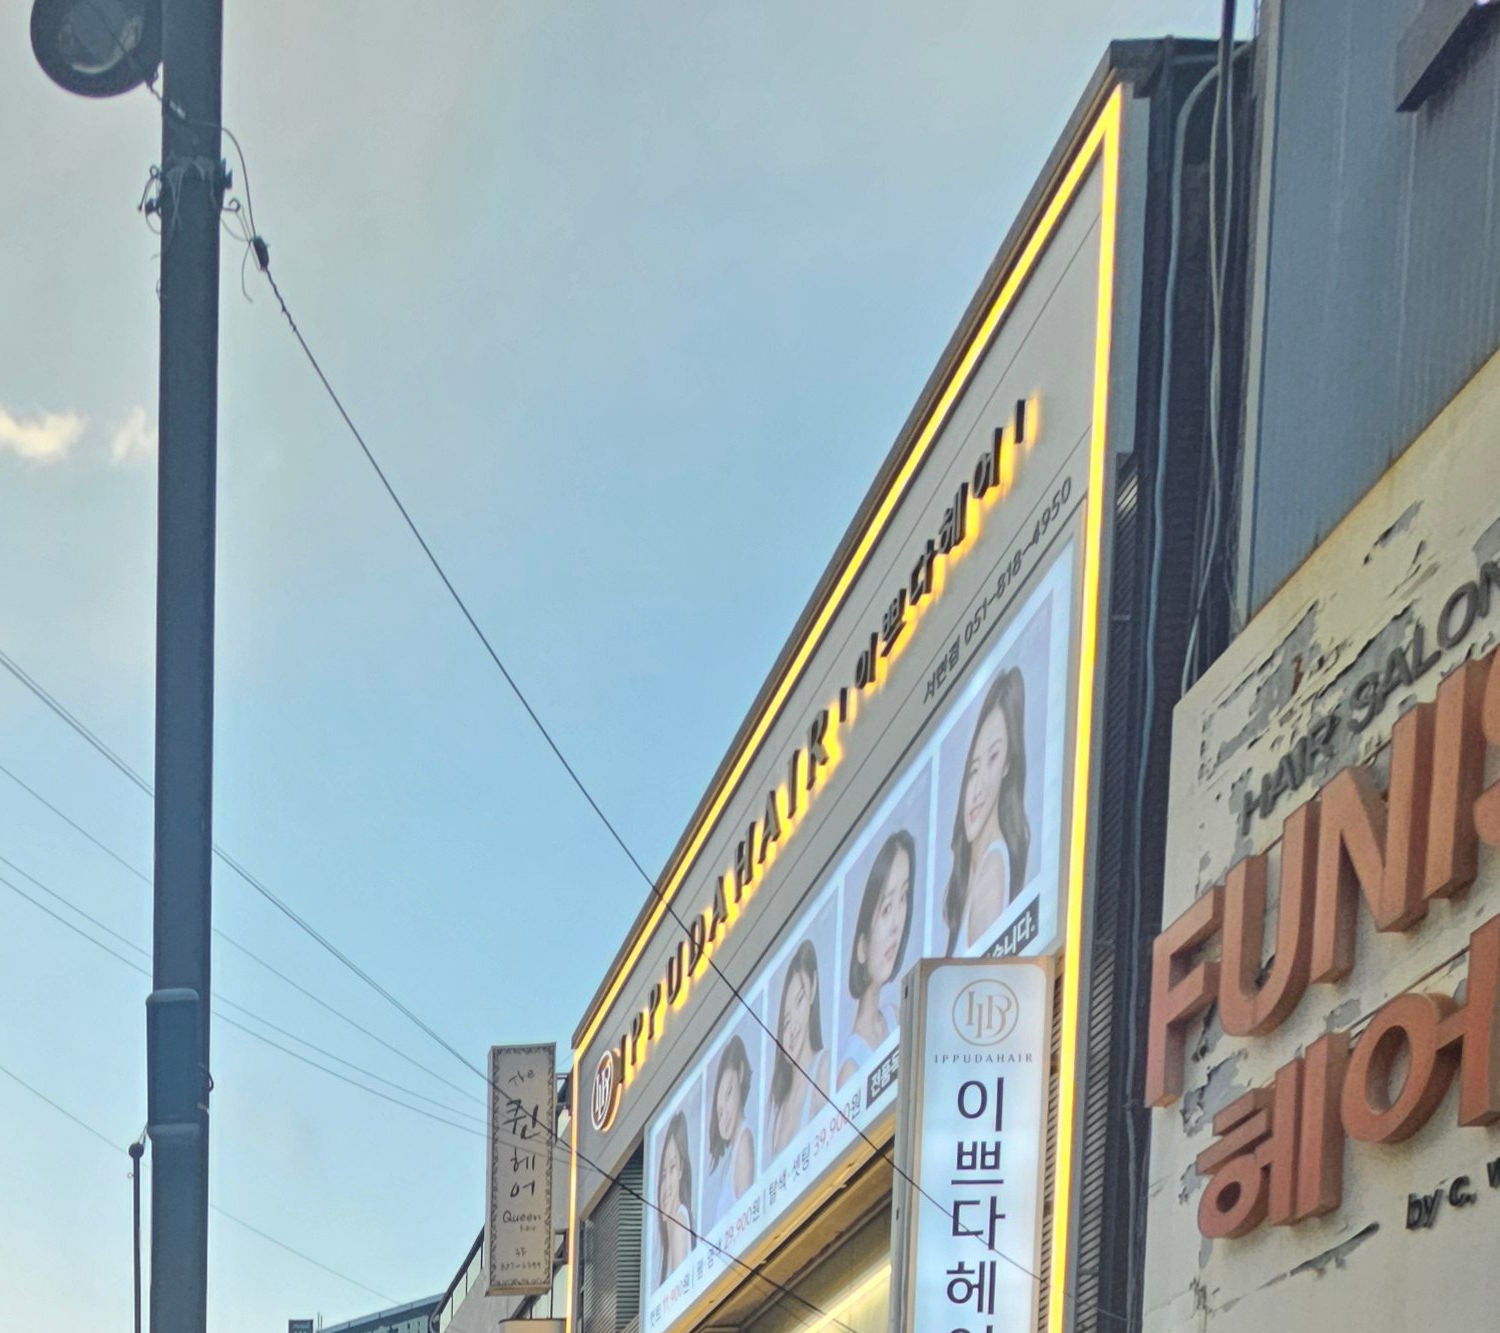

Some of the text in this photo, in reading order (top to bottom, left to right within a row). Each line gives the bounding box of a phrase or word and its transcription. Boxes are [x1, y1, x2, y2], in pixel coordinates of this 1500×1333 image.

[1145, 650, 1500, 1107] FUNI
[934, 1053, 1033, 1064] IPPUDAHAIR
[503, 1211, 541, 1224] Queen
